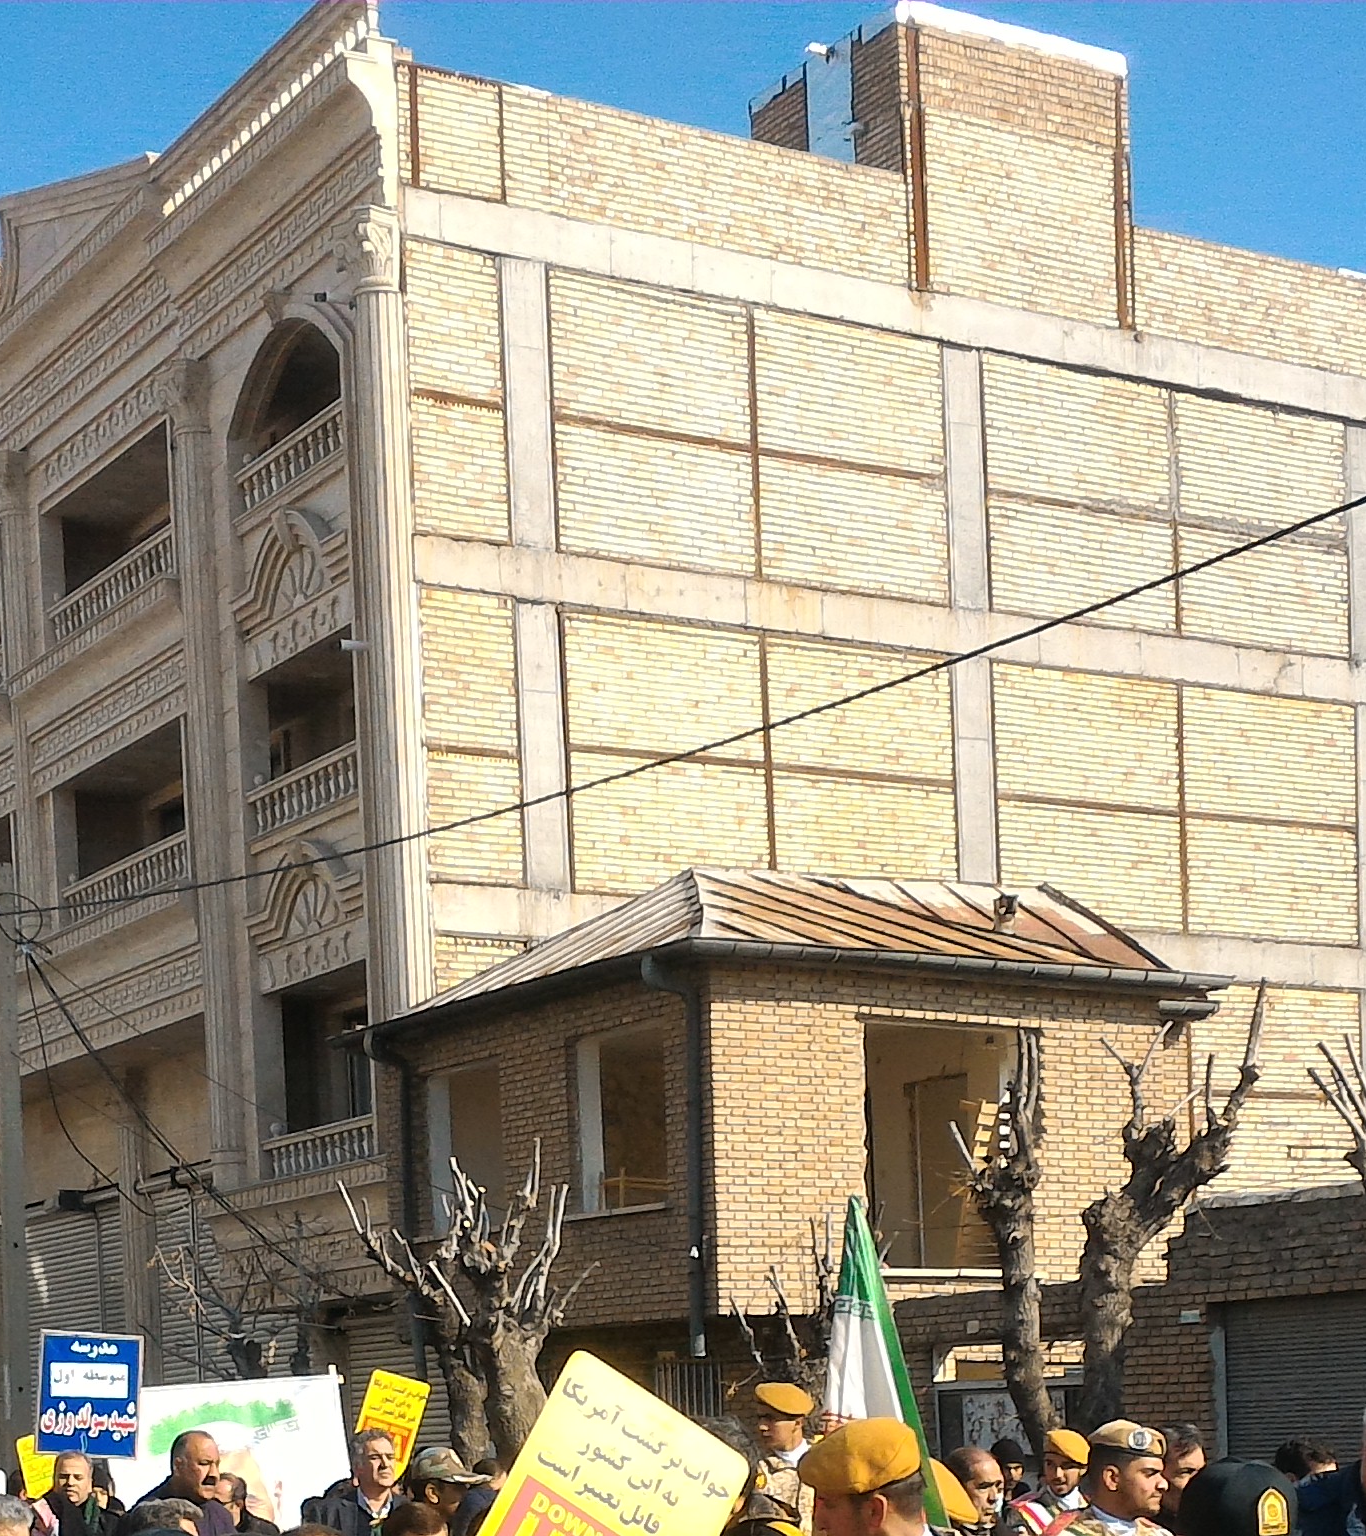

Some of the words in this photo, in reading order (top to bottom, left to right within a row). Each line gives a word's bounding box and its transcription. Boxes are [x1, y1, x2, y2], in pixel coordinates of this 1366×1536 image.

[70, 1340, 119, 1359] مدرسه
[53, 1369, 75, 1384] اول
[562, 1376, 625, 1424] آمریکا
